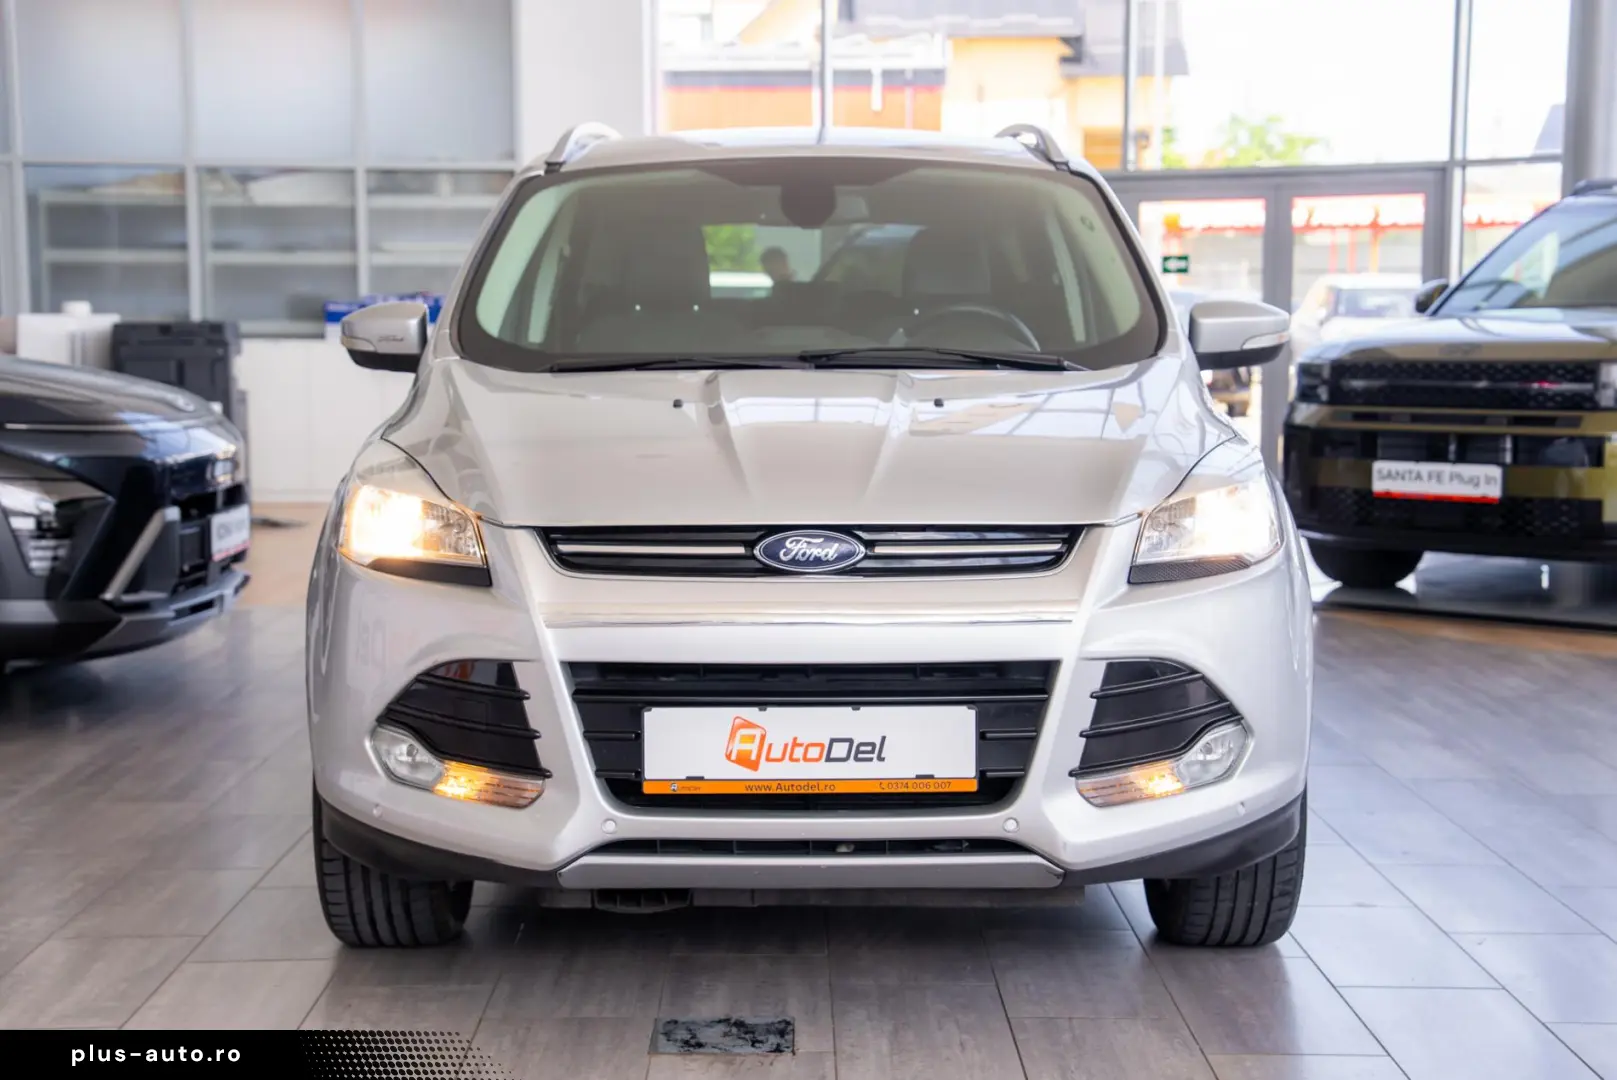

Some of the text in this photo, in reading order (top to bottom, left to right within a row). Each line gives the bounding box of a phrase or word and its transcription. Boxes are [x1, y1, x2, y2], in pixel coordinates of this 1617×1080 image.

[1376, 467, 1423, 482] SANTA
[1427, 470, 1447, 485] FE
[1450, 472, 1480, 490] Plug
[779, 536, 839, 562] Ford
[727, 726, 886, 764] AutoDel
[744, 782, 836, 792] www.Autodel.ro
[887, 781, 952, 790] 0374 006 007
